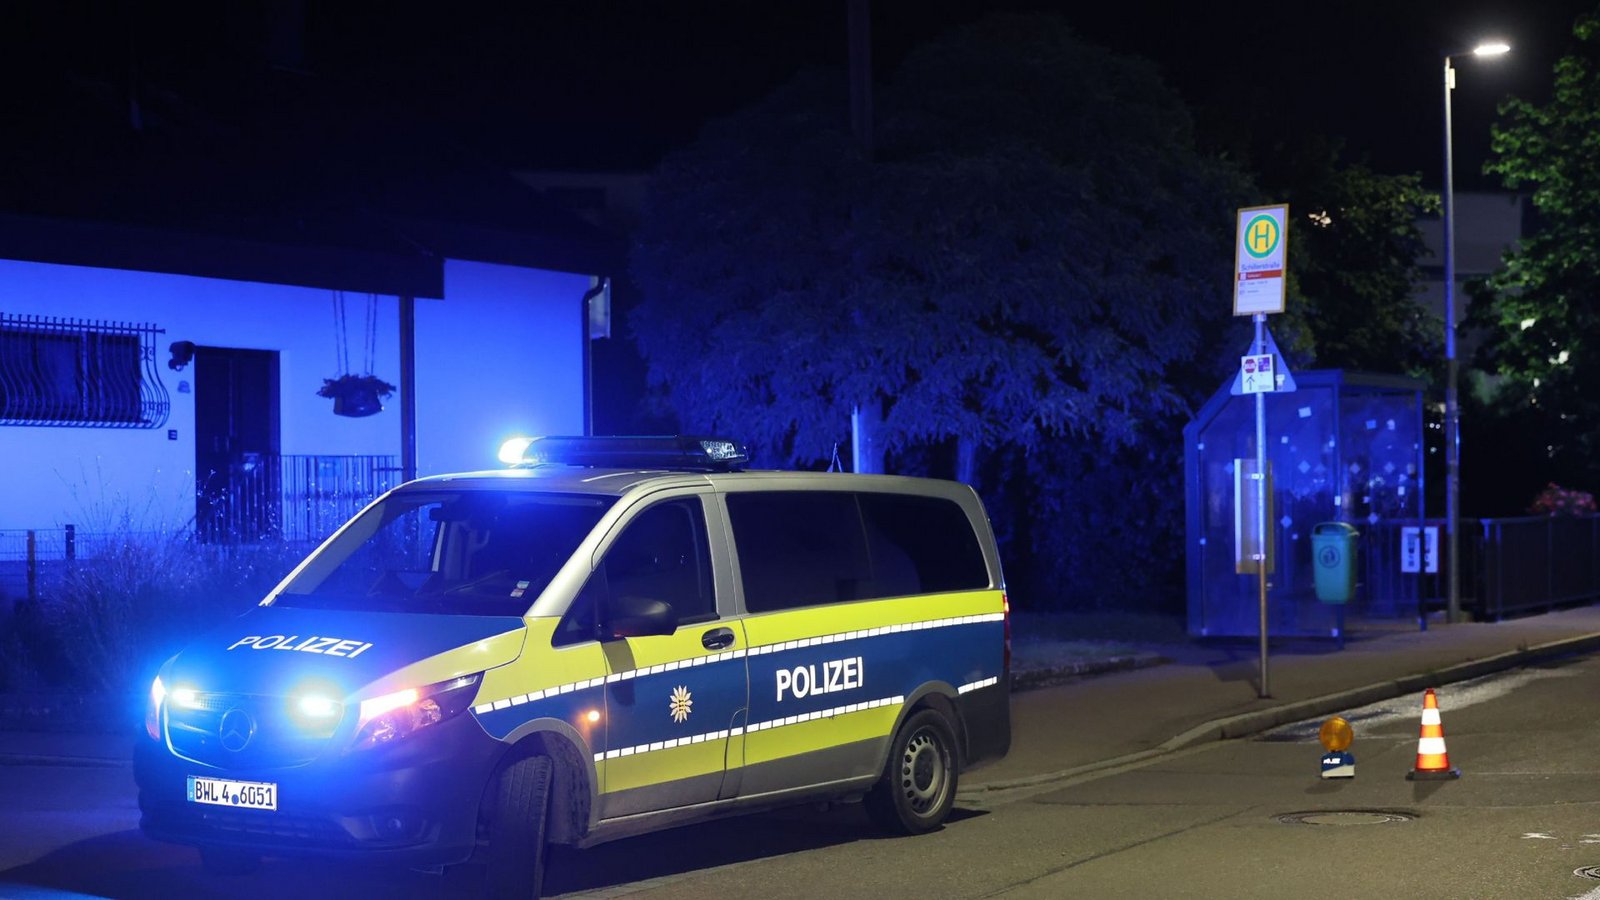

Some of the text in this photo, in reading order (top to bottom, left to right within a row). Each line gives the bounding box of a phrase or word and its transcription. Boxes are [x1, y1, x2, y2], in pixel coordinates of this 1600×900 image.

[1254, 223, 1269, 249] H
[227, 635, 373, 659] POLIZEI
[776, 656, 863, 702] POLIZEI
[195, 781, 273, 806] BWL 4 6051
